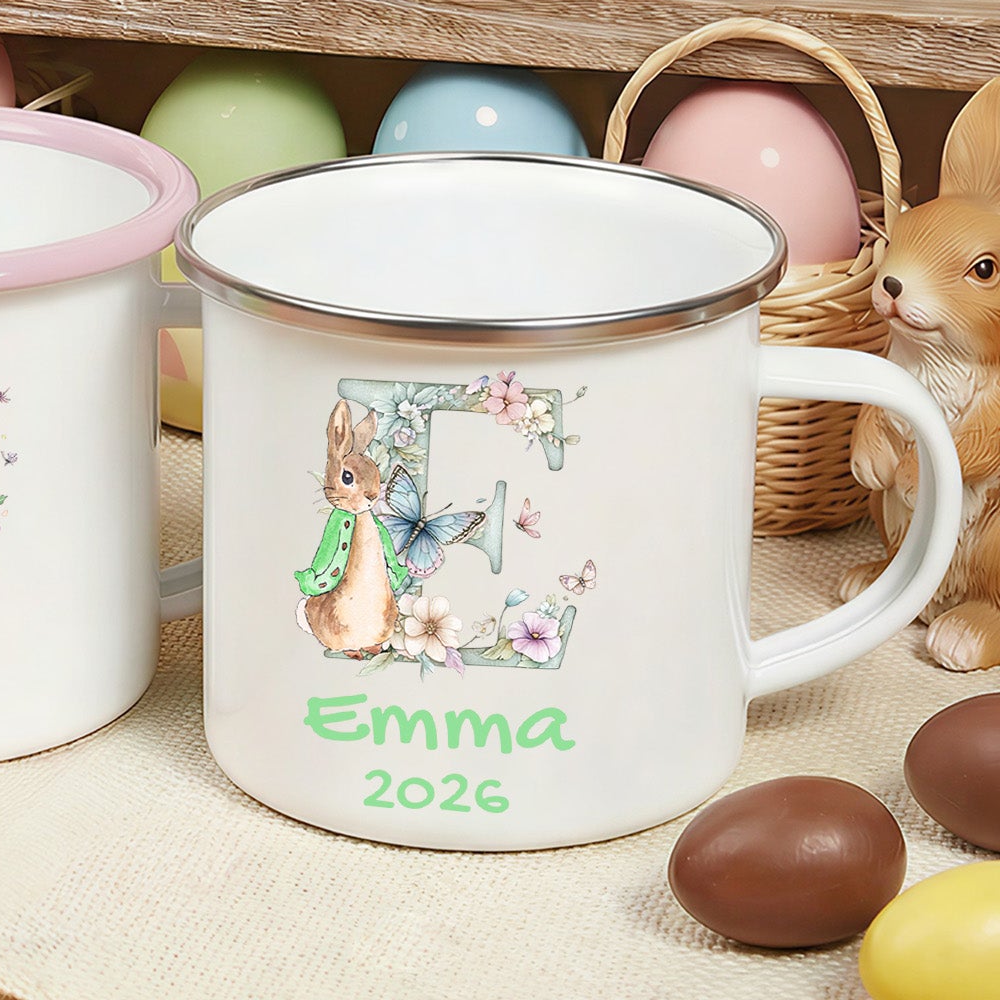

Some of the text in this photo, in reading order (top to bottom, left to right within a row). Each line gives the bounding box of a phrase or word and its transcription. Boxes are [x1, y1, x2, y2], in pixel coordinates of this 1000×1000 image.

[323, 376, 578, 671] E
[303, 693, 577, 754] Emma
[363, 769, 511, 814] 2026
